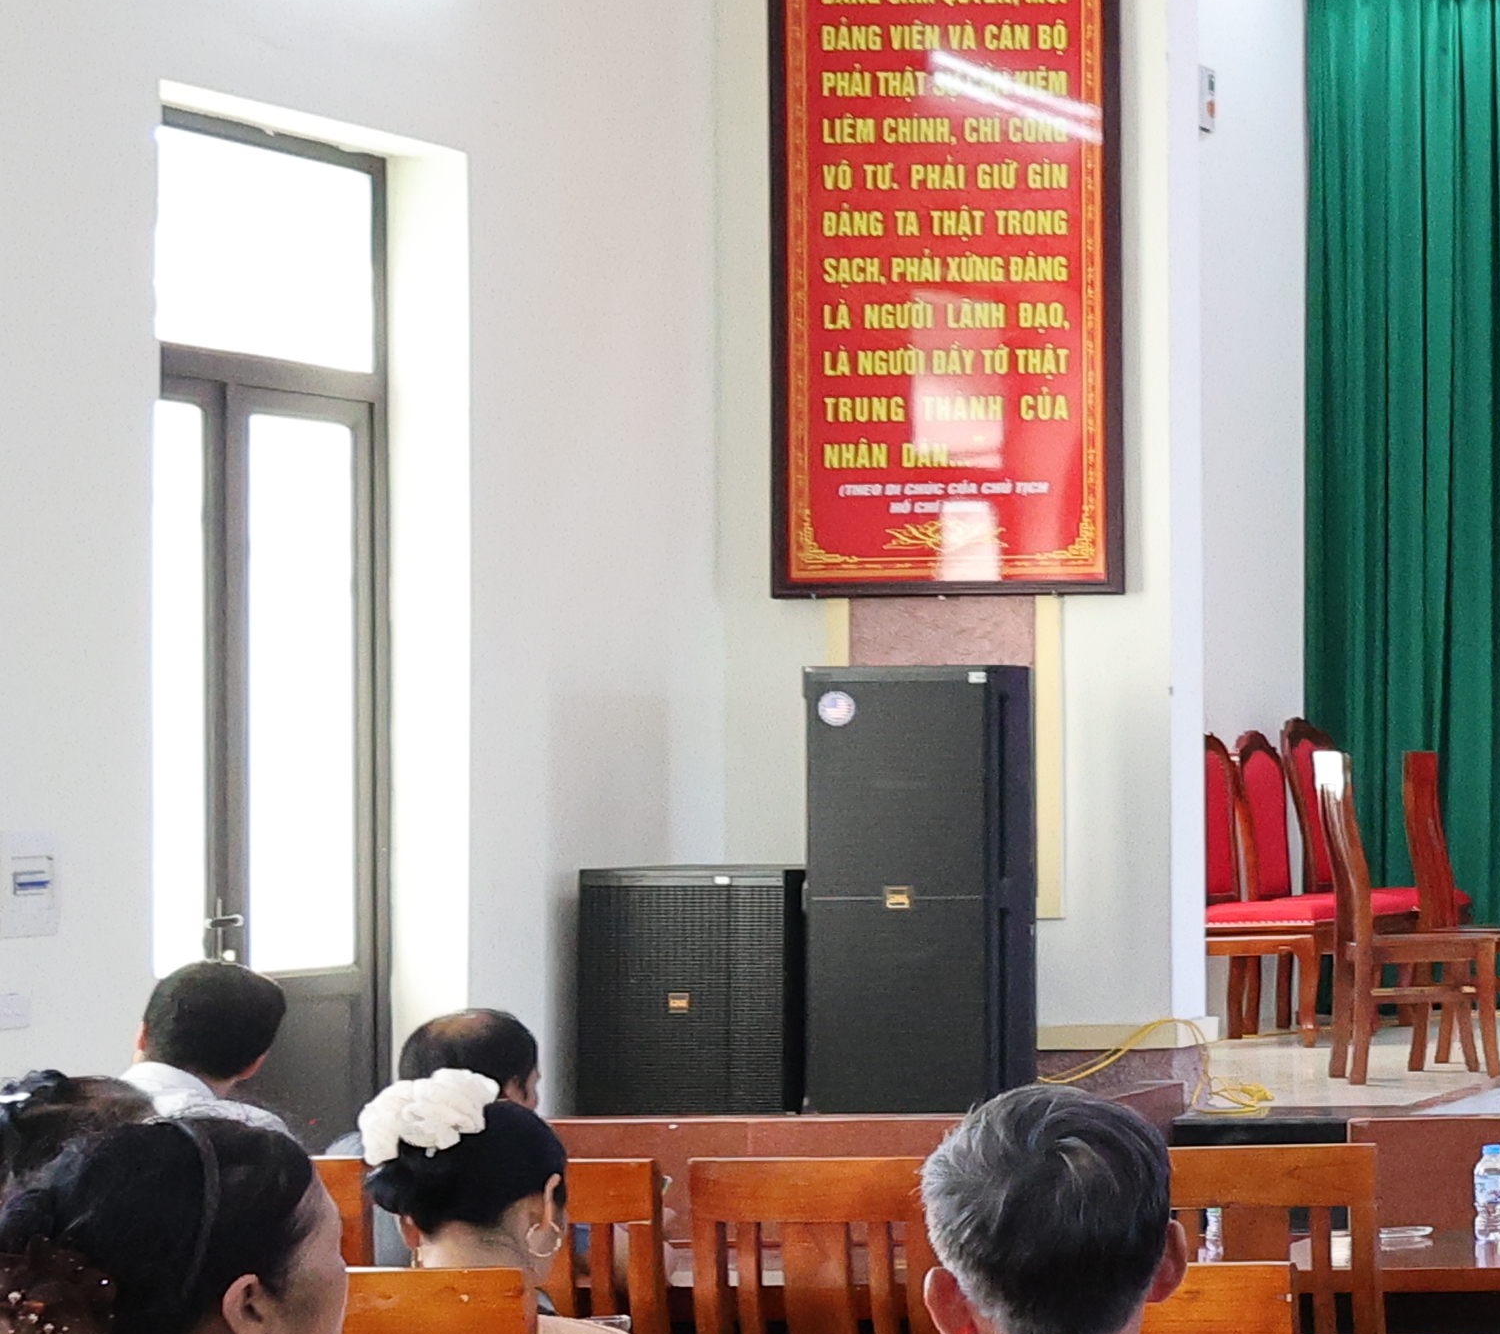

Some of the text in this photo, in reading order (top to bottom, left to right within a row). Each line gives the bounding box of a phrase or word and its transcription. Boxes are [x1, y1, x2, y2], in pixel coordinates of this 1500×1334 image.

[821, 17, 1069, 55] ĐẢNG VIÊN VÀ BỘ
[821, 64, 873, 97] PHẢI
[876, 65, 928, 102] THẬT
[822, 113, 876, 143] LIÊM
[822, 160, 853, 190] VÔ
[862, 162, 898, 190] TƯ.
[910, 155, 966, 189] PHẢI
[1027, 159, 1069, 189] GÌN
[822, 203, 1069, 241] ĐẢNG TA THẬT TRONG
[822, 258, 887, 288] SẠCH,
[890, 249, 942, 282] PHẢI
[823, 299, 852, 329] LÀ
[863, 298, 933, 329] NGƯỜI
[1018, 302, 1070, 333] ĐẠO,
[823, 344, 1070, 379] LÀ NGƯỜI THẬT
[823, 396, 906, 423] TRUNG
[1020, 387, 1069, 420] CỦA
[823, 438, 888, 468] NHÂN
